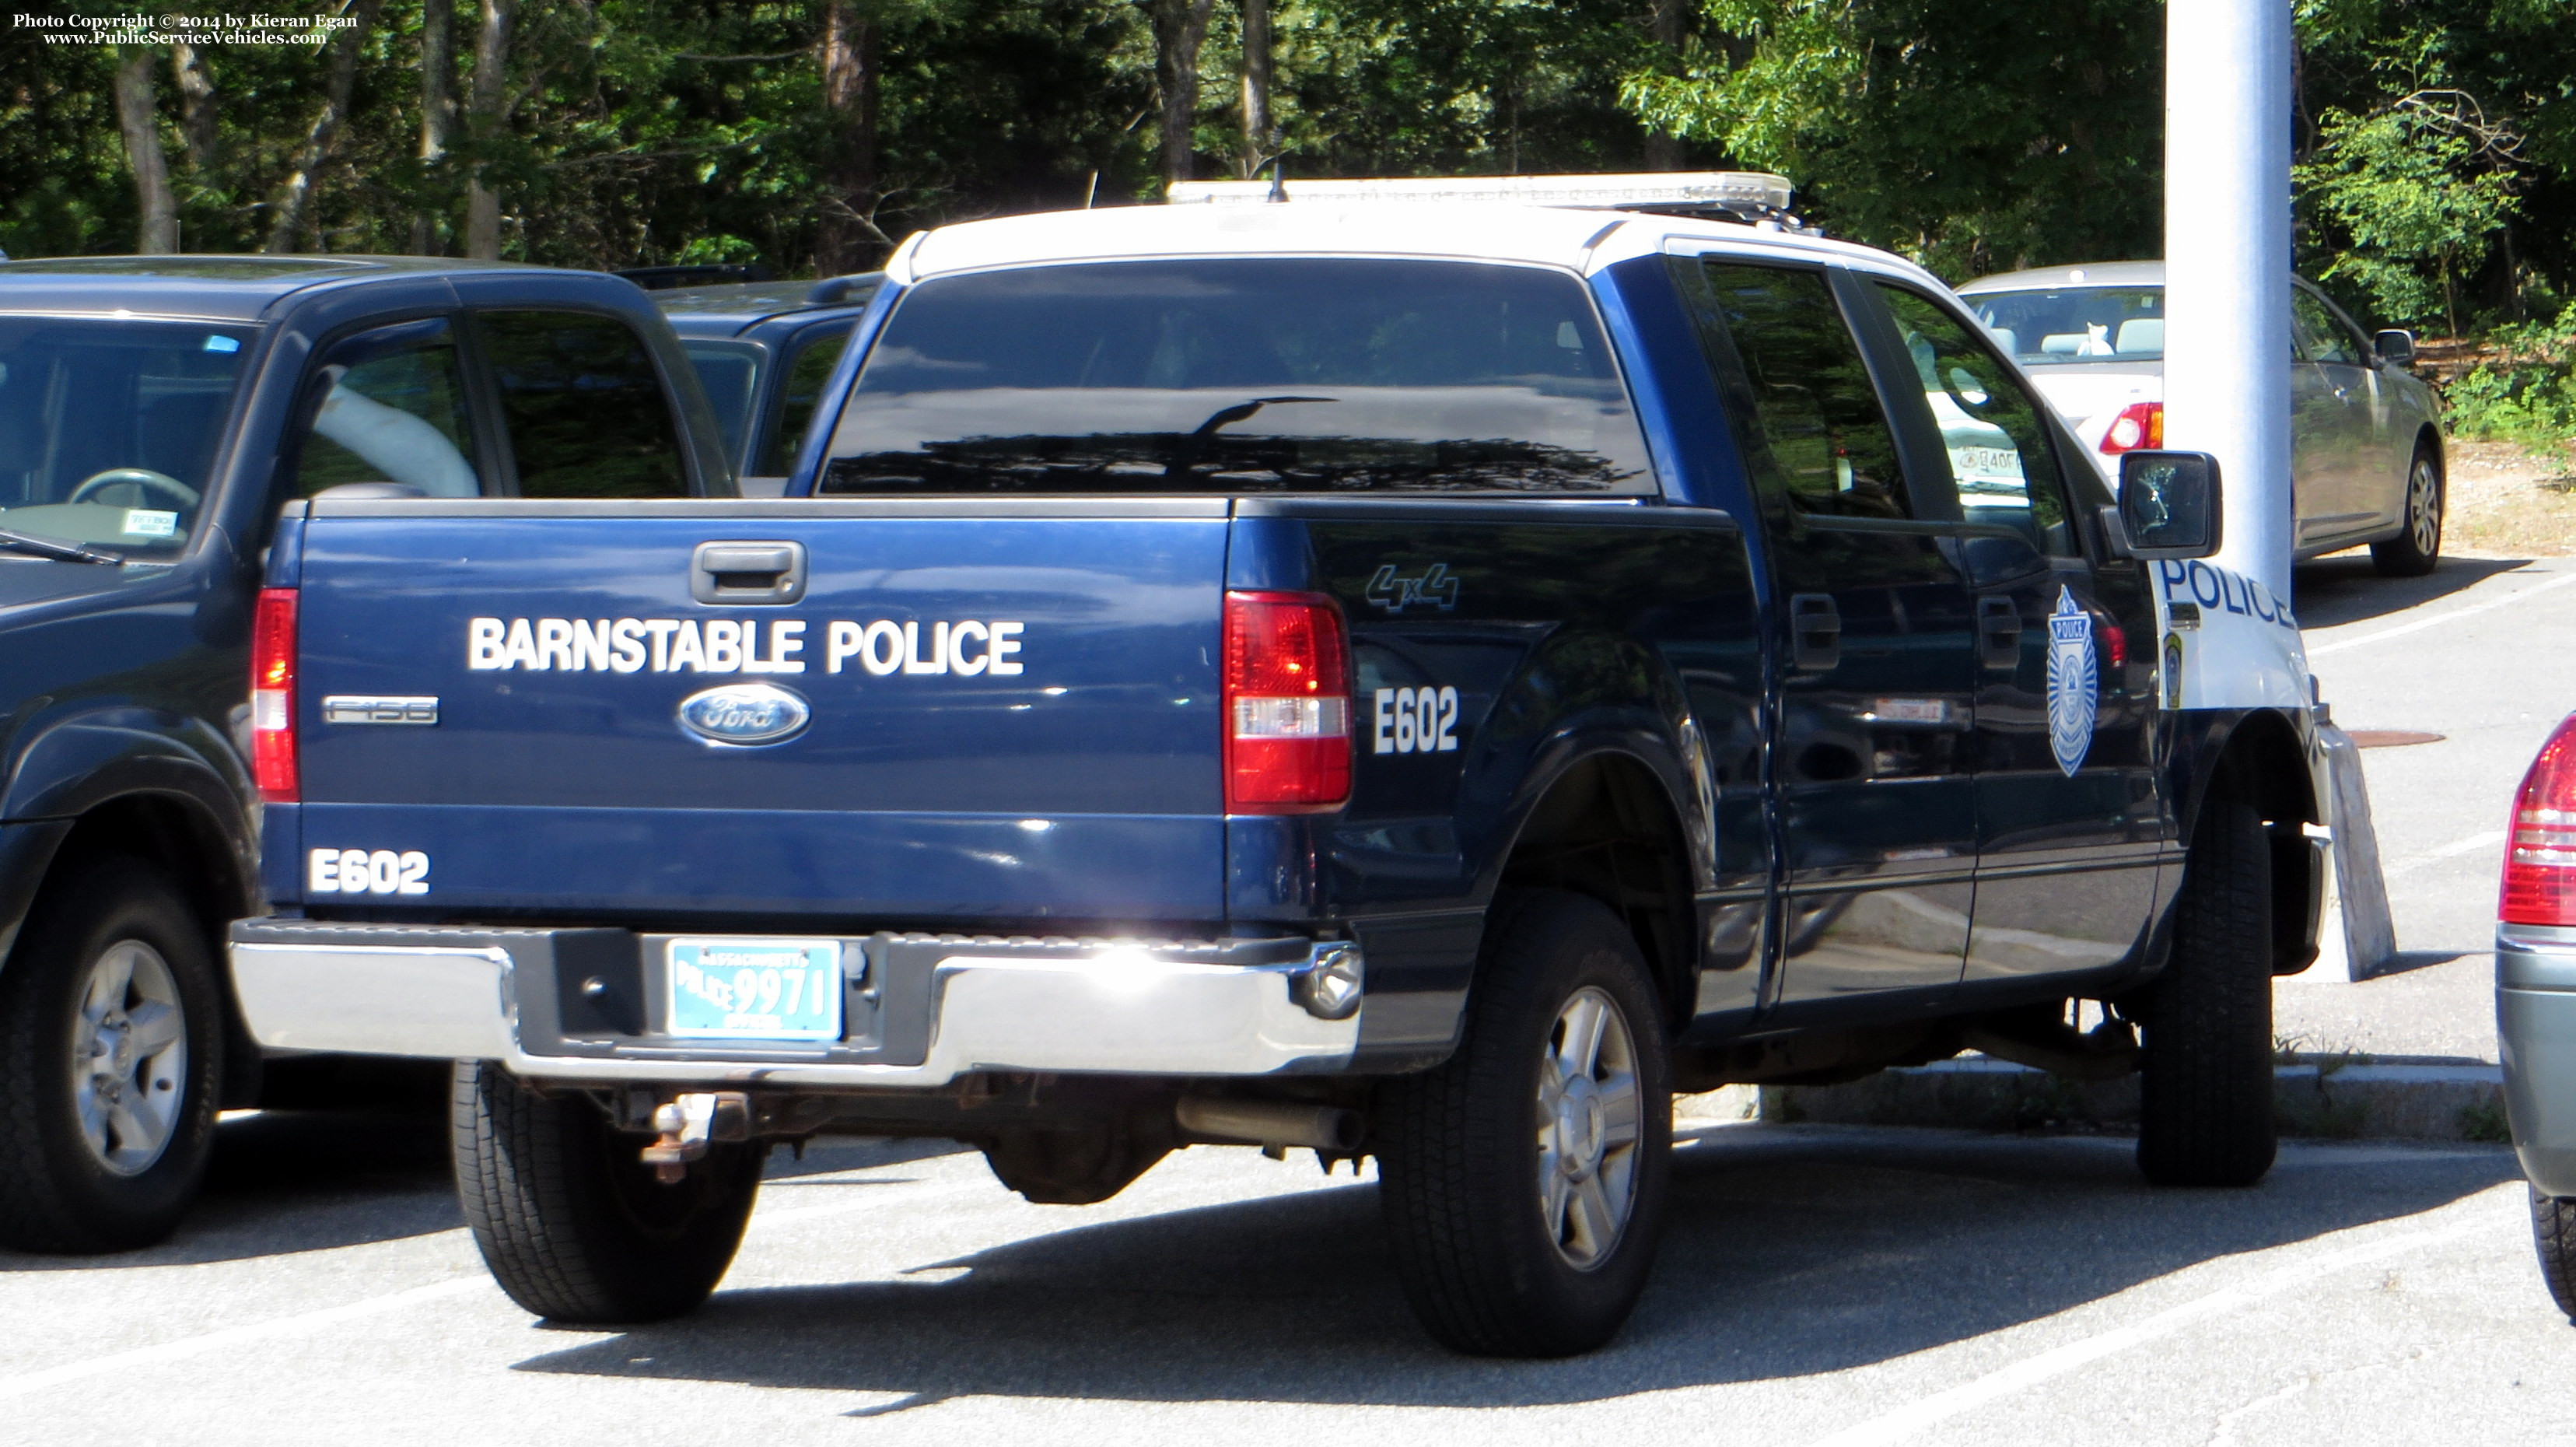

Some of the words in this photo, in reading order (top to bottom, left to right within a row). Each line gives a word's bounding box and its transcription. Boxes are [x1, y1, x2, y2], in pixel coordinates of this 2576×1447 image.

[2160, 559, 2298, 629] POLICE
[468, 618, 807, 674] BARNSTABLE
[828, 621, 1024, 675] POLICE
[2056, 621, 2083, 638] POLICE
[702, 699, 778, 728] Ford
[1374, 685, 1458, 754] E602
[310, 848, 430, 895] E602
[733, 968, 824, 1016] 9971
